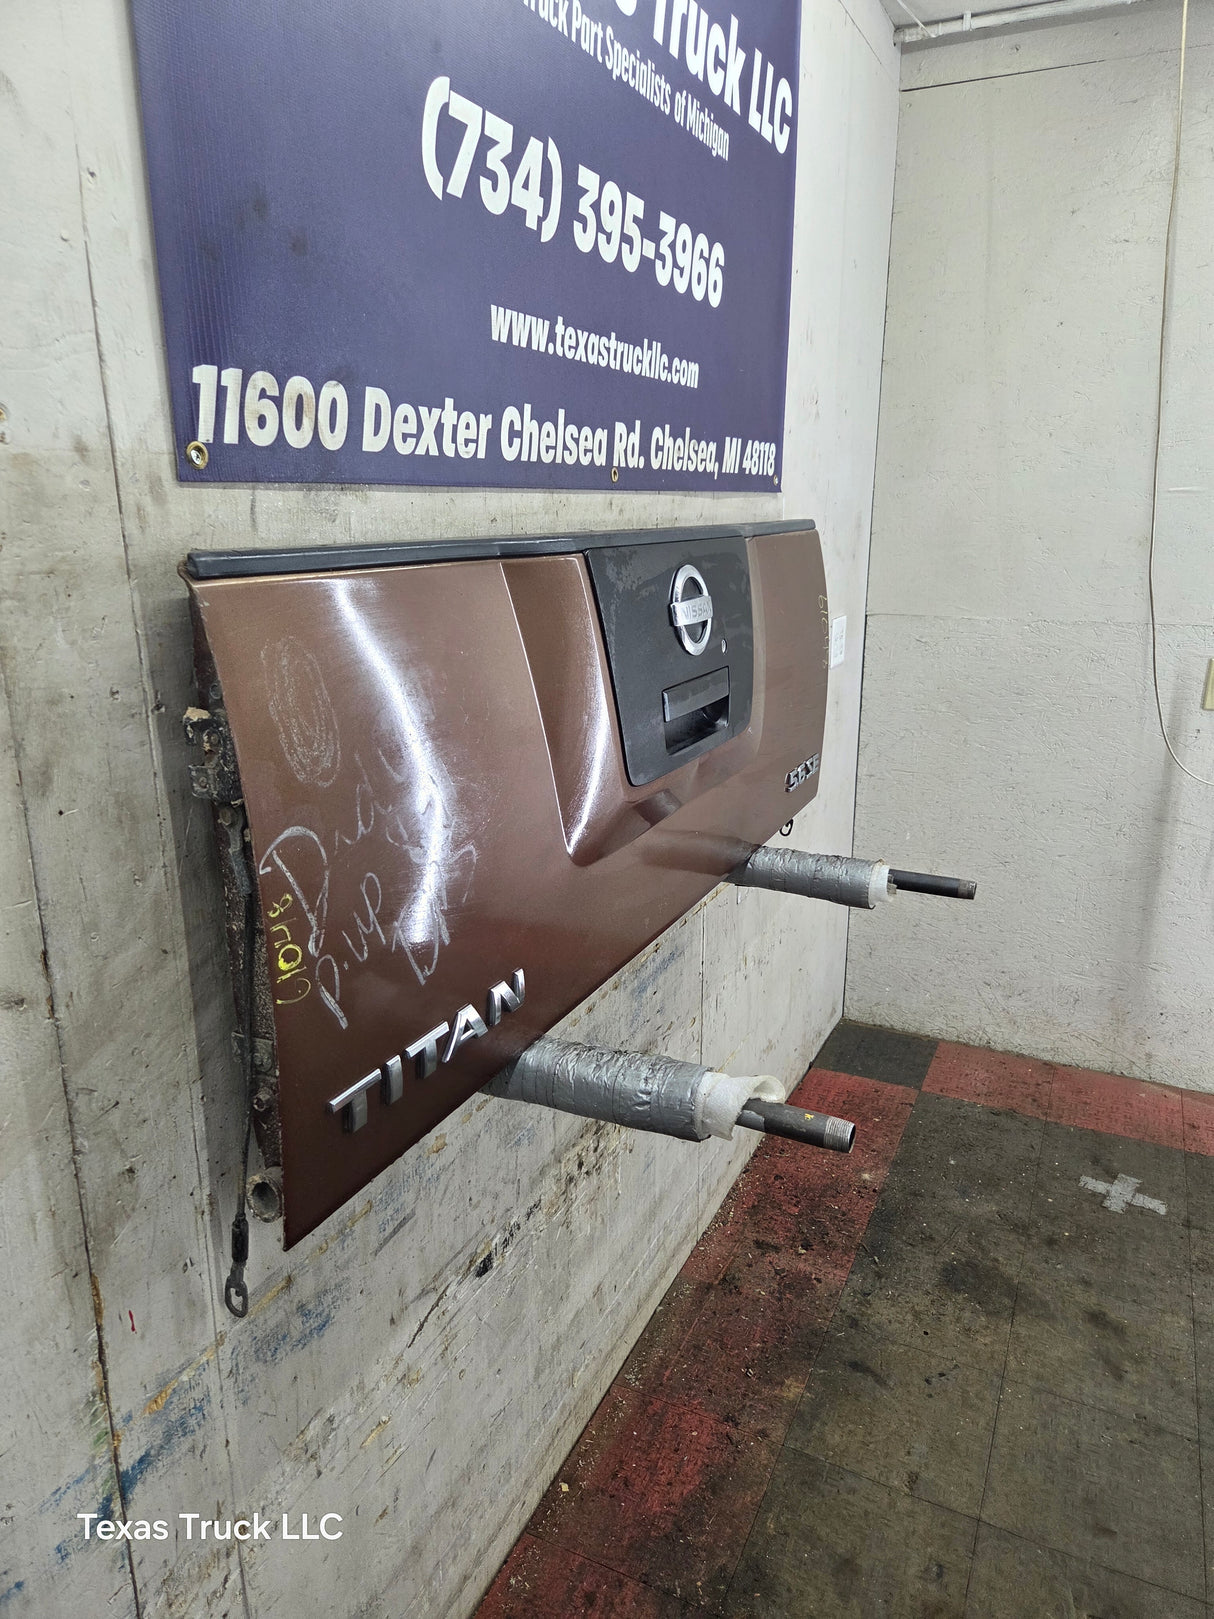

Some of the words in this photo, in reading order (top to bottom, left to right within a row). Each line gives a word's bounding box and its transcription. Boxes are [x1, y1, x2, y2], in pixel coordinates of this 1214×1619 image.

[523, 0, 569, 37] uck
[571, 0, 604, 63] Part
[605, 25, 671, 116] Specialists
[674, 89, 688, 126] of
[687, 94, 729, 161] Michigan
[748, 47, 793, 154] LLC
[421, 76, 563, 243] (734)
[573, 163, 725, 308] 395-3966
[490, 304, 700, 389] www.texastruckllc.com
[192, 364, 349, 451] 11600
[362, 386, 493, 459] Dexter
[501, 403, 608, 466] Chelsea
[612, 419, 645, 469] Rd.
[649, 424, 719, 480] Chelsea,
[721, 436, 742, 474] MI
[742, 439, 777, 477] 48118
[682, 599, 712, 619] NISSAN
[327, 967, 526, 1134] TITAN
